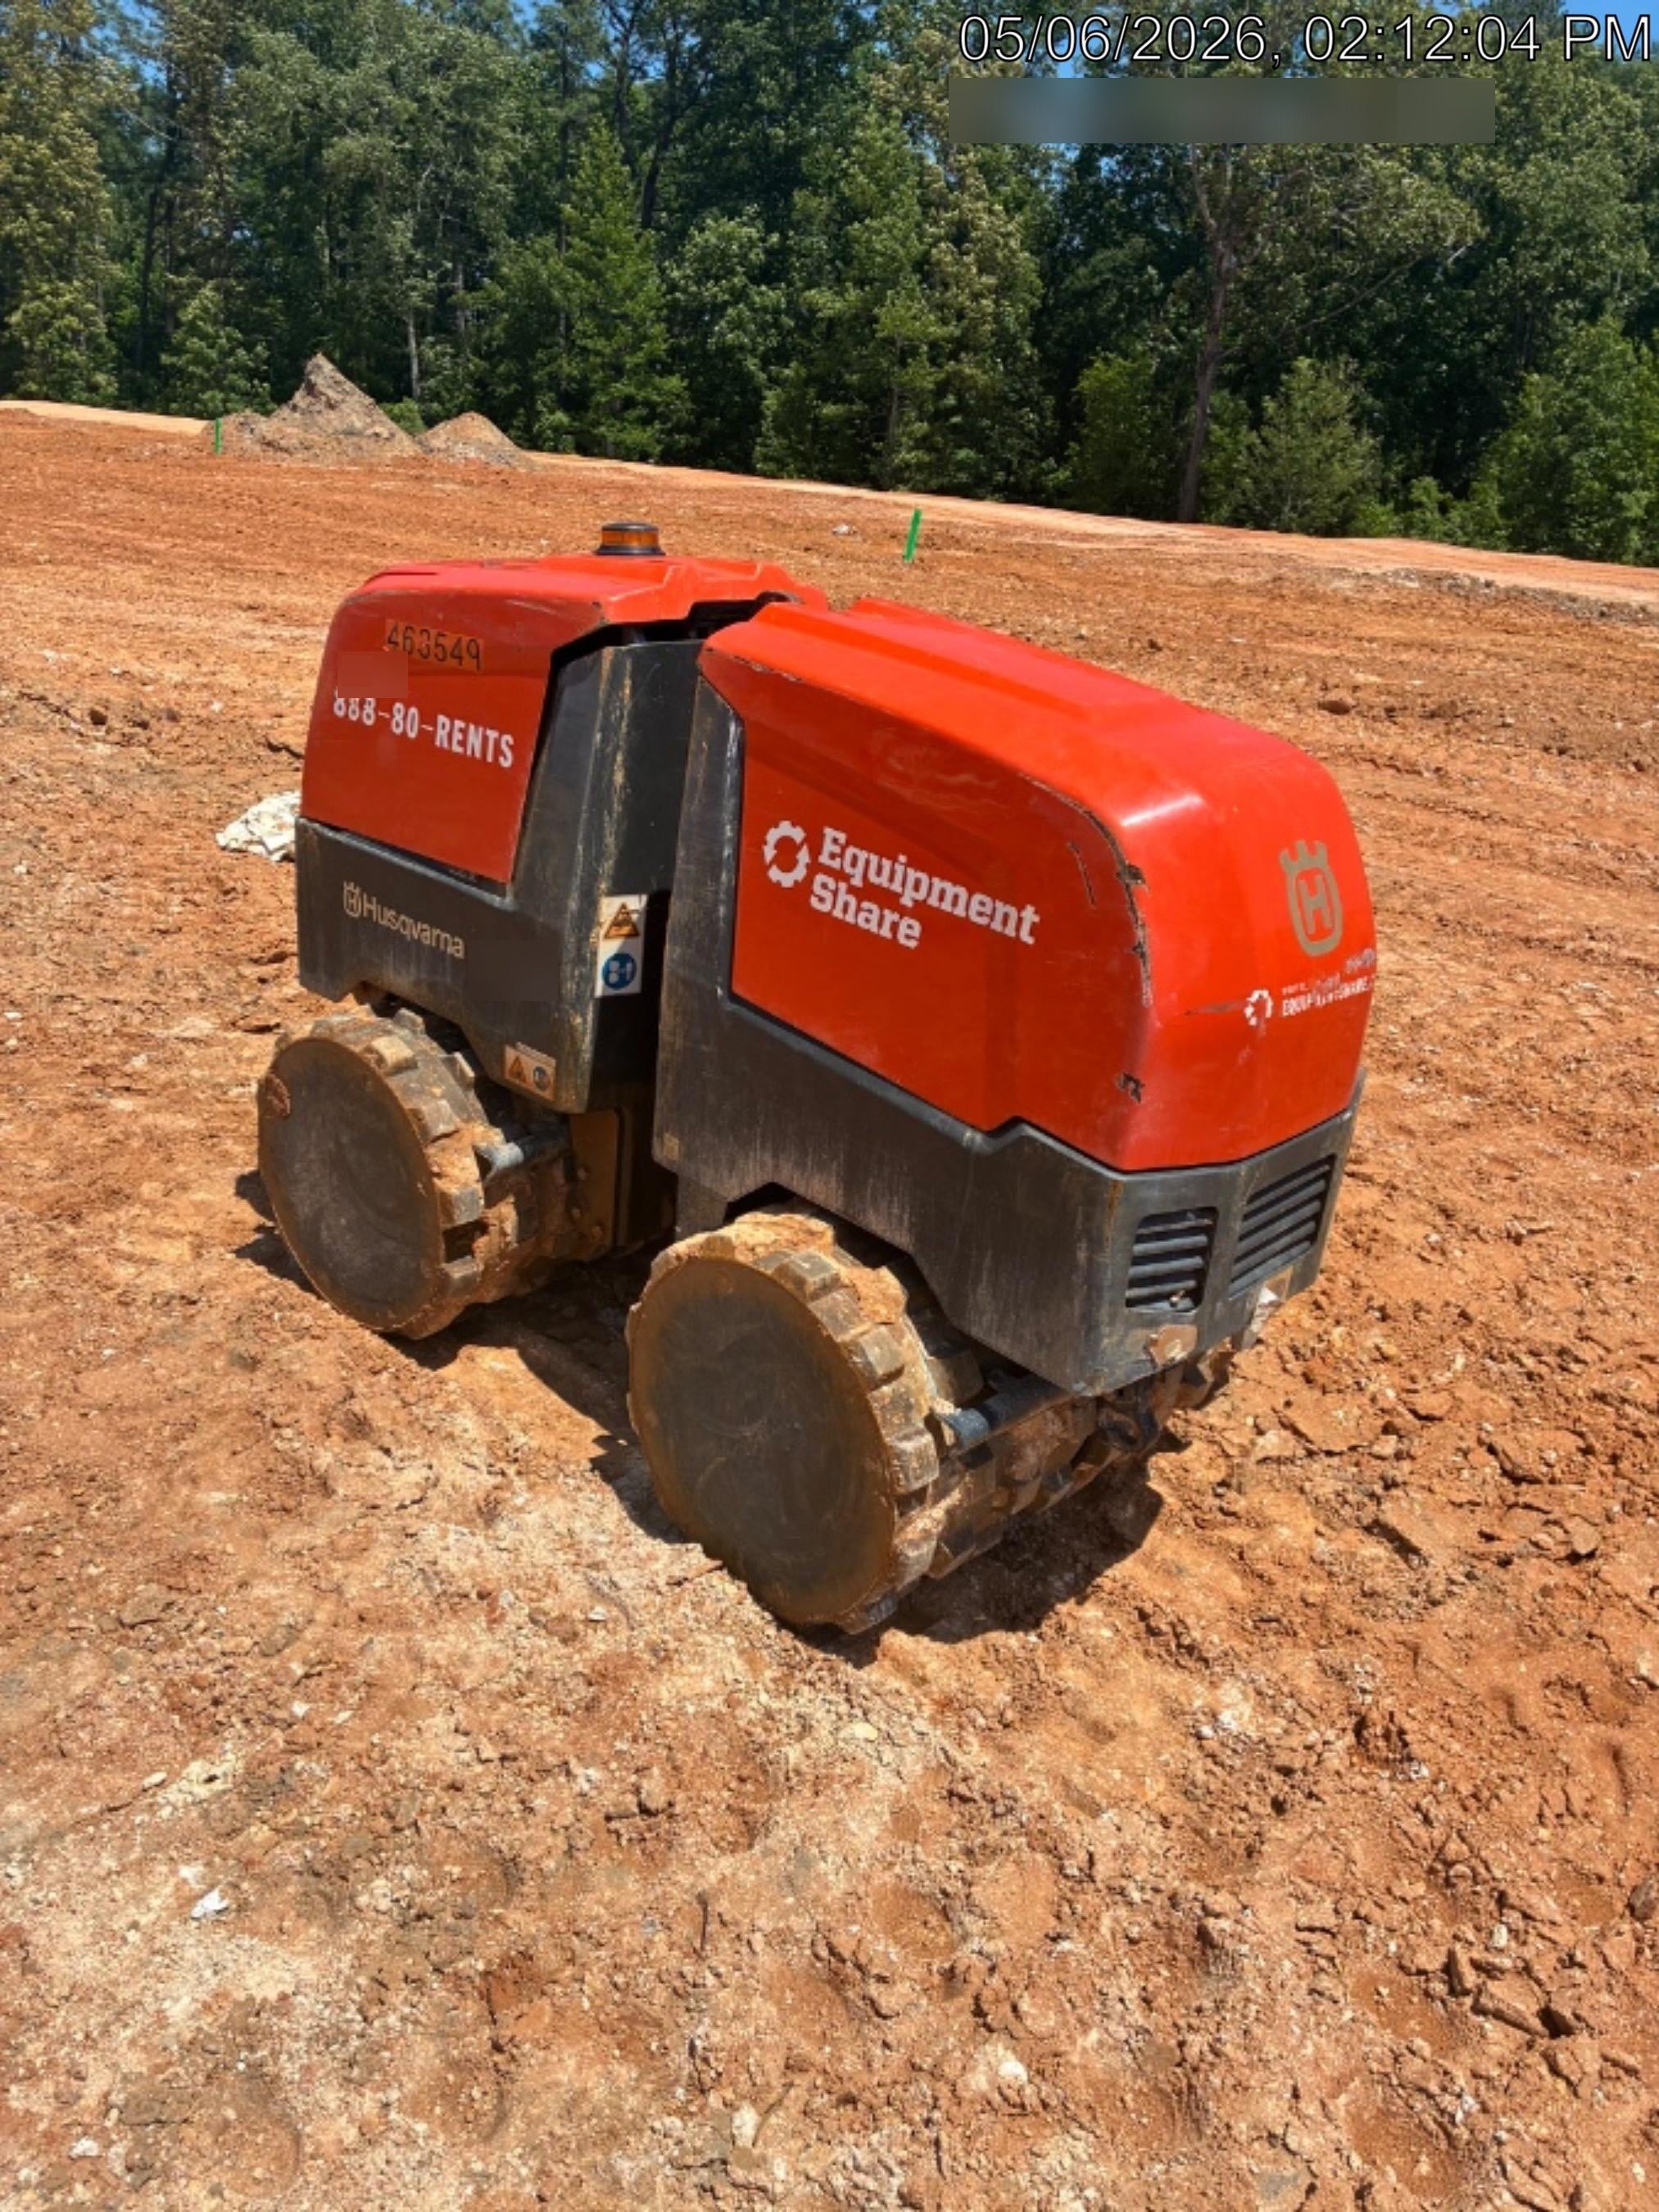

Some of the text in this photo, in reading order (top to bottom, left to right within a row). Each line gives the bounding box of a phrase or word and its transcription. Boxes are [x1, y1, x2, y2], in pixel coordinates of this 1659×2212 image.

[386, 622, 483, 671] 463549
[809, 873, 922, 950] Share
[818, 826, 1041, 945] Equipment
[361, 894, 465, 960] Husqvarna
